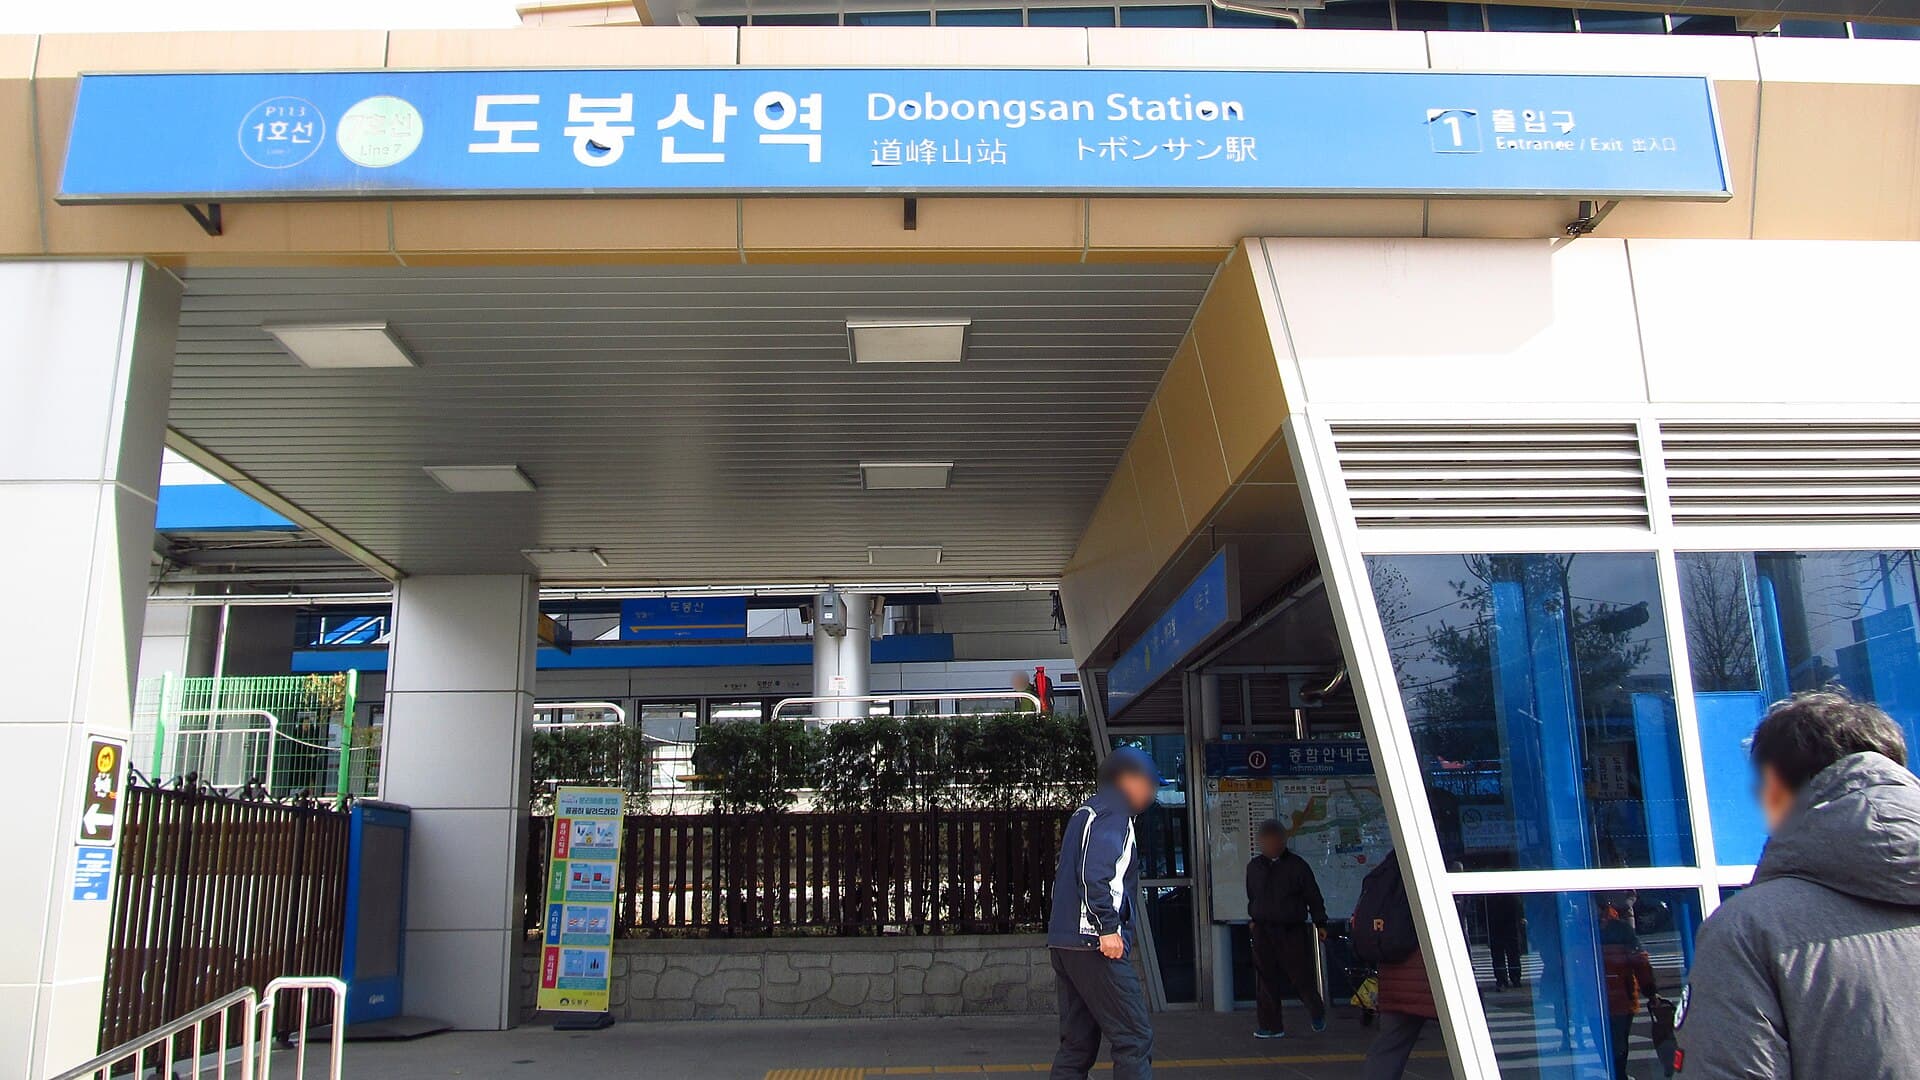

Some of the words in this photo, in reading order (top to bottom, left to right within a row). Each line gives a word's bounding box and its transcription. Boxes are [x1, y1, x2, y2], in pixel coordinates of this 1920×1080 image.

[867, 92, 1093, 128] Dobongsan
[1106, 93, 1243, 121] Station
[1491, 108, 1576, 134] 출입구
[253, 120, 313, 144] 1호선
[467, 90, 824, 167] 도봉산역
[1442, 116, 1463, 147] 1
[871, 138, 1008, 164] 道峰山站
[1078, 135, 1259, 162] トボンサン駅
[1496, 137, 1574, 151] Entrance
[1591, 137, 1623, 151] Exit
[1289, 747, 1370, 763] 종합안내도
